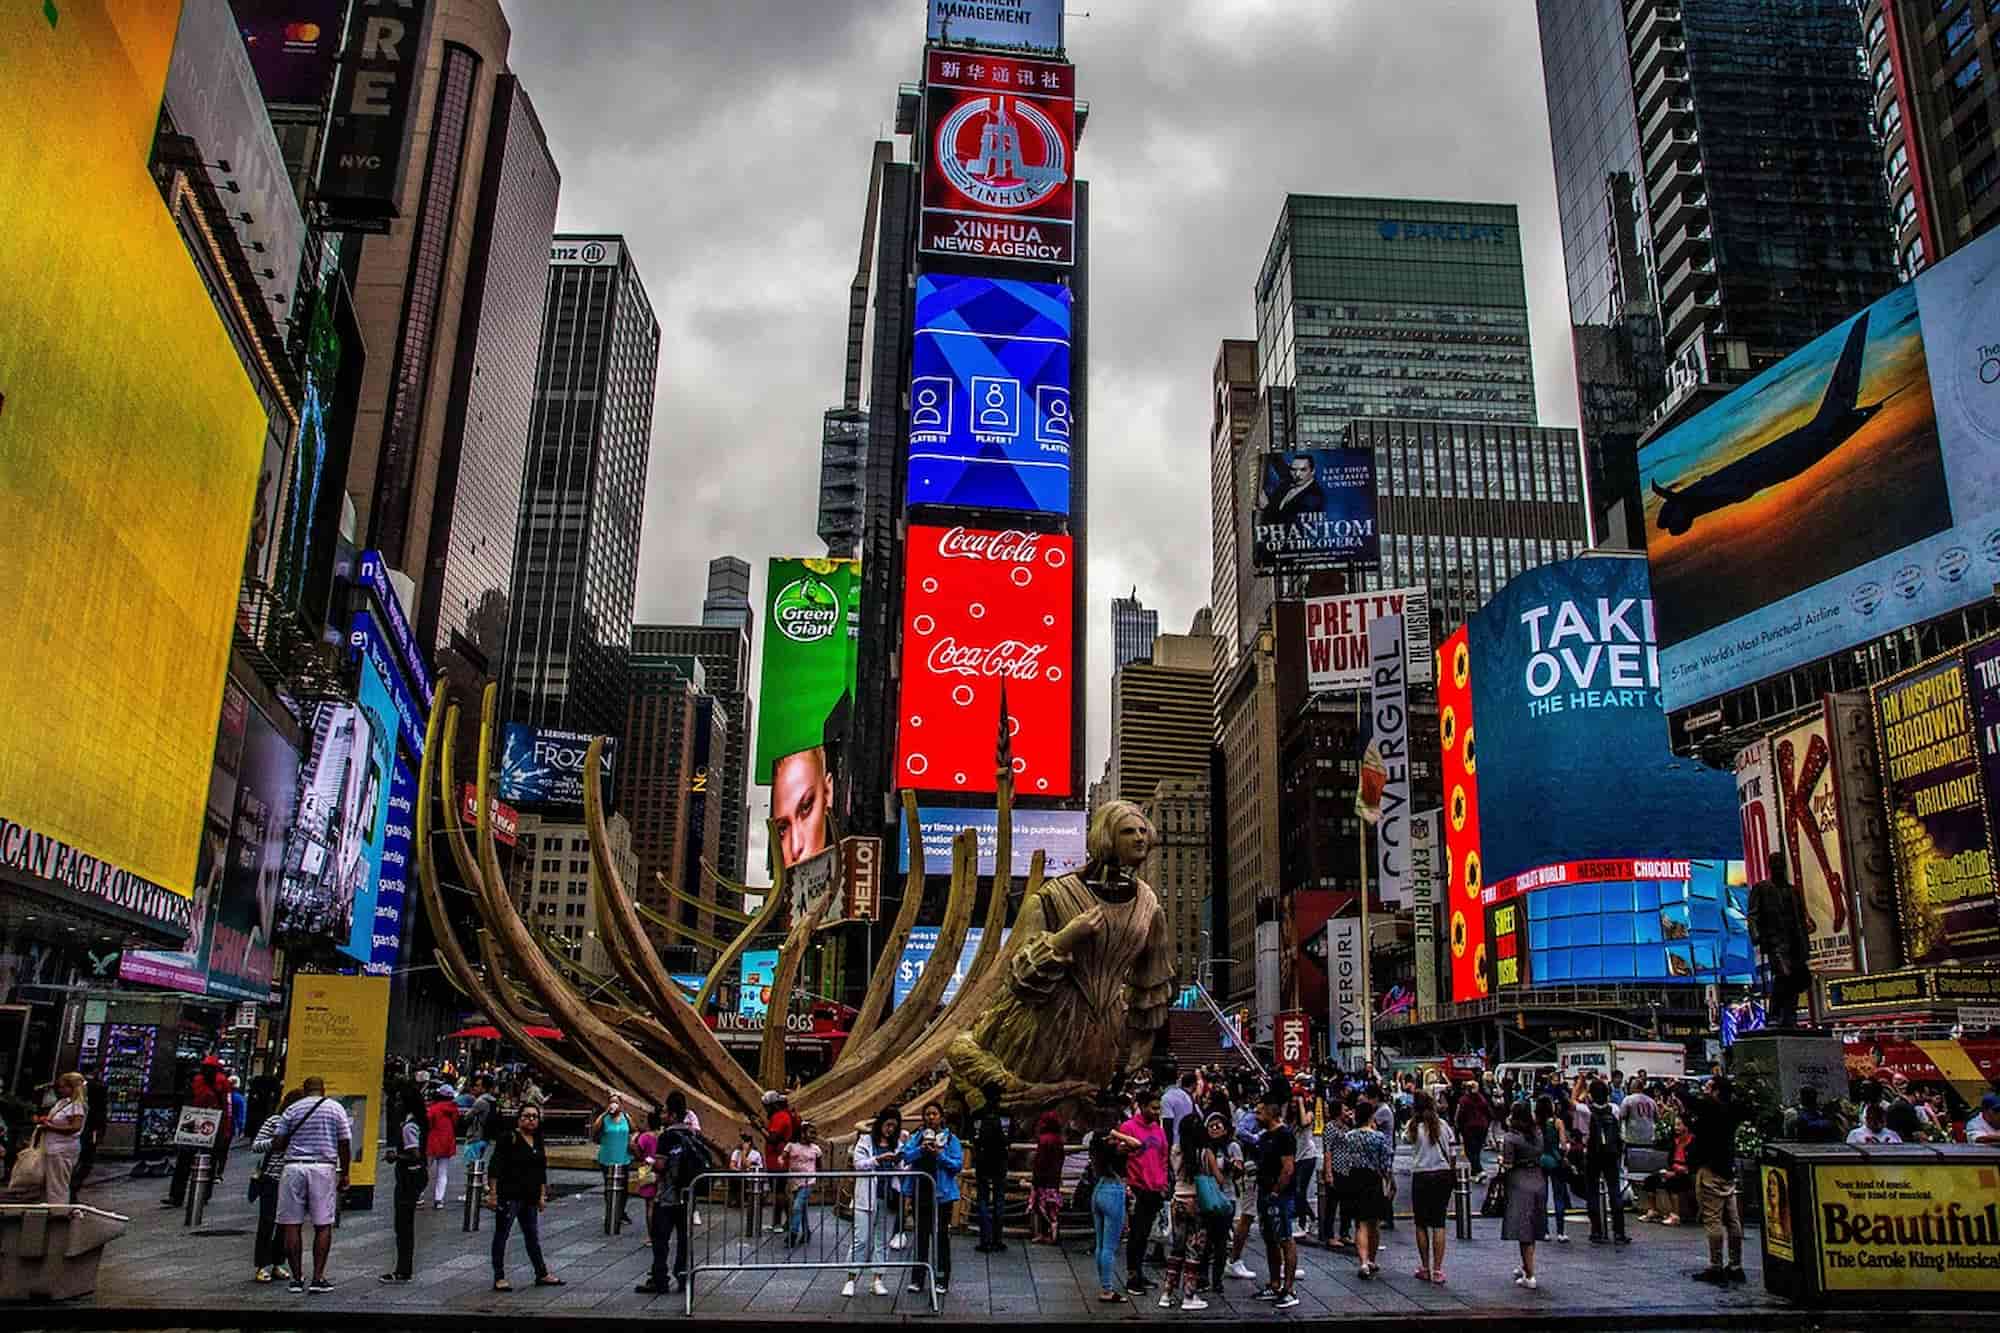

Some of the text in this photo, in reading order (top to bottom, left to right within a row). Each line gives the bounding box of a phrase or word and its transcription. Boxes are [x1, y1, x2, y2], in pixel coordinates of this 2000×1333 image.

[936, 4, 1032, 24] MANAGEMENT
[940, 61, 1060, 89] 新华通讯社
[339, 155, 382, 169] NYC
[964, 182, 1041, 204] XINHUA
[953, 219, 1043, 243] XINHUA
[933, 235, 1062, 259] NEWS AGENCY
[975, 435, 1007, 444] PLAYER
[1255, 519, 1375, 542] PHANTOM
[1297, 511, 1328, 523] THE
[938, 526, 1042, 563] Coca-Cola
[1266, 540, 1285, 552] OF
[1316, 536, 1364, 549] OPERA
[782, 606, 834, 620] Green
[787, 621, 834, 635] Giant
[1700, 645, 1735, 668] World's
[1736, 633, 1760, 654] Most
[1804, 605, 1841, 627] Airline
[928, 637, 1048, 681] Coca-Cola
[1308, 634, 1369, 673] WOM
[1528, 695, 1564, 718] THE
[1570, 690, 1648, 710] HEART
[1881, 666, 1963, 727] AN INSPIRED
[1885, 699, 1967, 759] BROADWAY
[533, 740, 613, 772] FROZN
[1373, 639, 1407, 878] COVERGIRL
[1889, 734, 1972, 782] EXTRAVAGANZA!
[1913, 773, 1979, 818] BRILLIANT!
[54, 840, 112, 900] EAGLE
[855, 841, 873, 918] HELLO!
[1633, 861, 1691, 879] CHOCOLATE
[1411, 848, 1433, 943] EXPERIENCE
[717, 1012, 744, 1030] NYC
[786, 1013, 815, 1032] OGS
[1283, 1020, 1305, 1061] tkts
[1822, 1201, 2000, 1247] Beautiful
[1826, 1250, 1856, 1269] The
[1857, 1250, 1905, 1269] Carole
[1908, 1250, 1945, 1273] King
